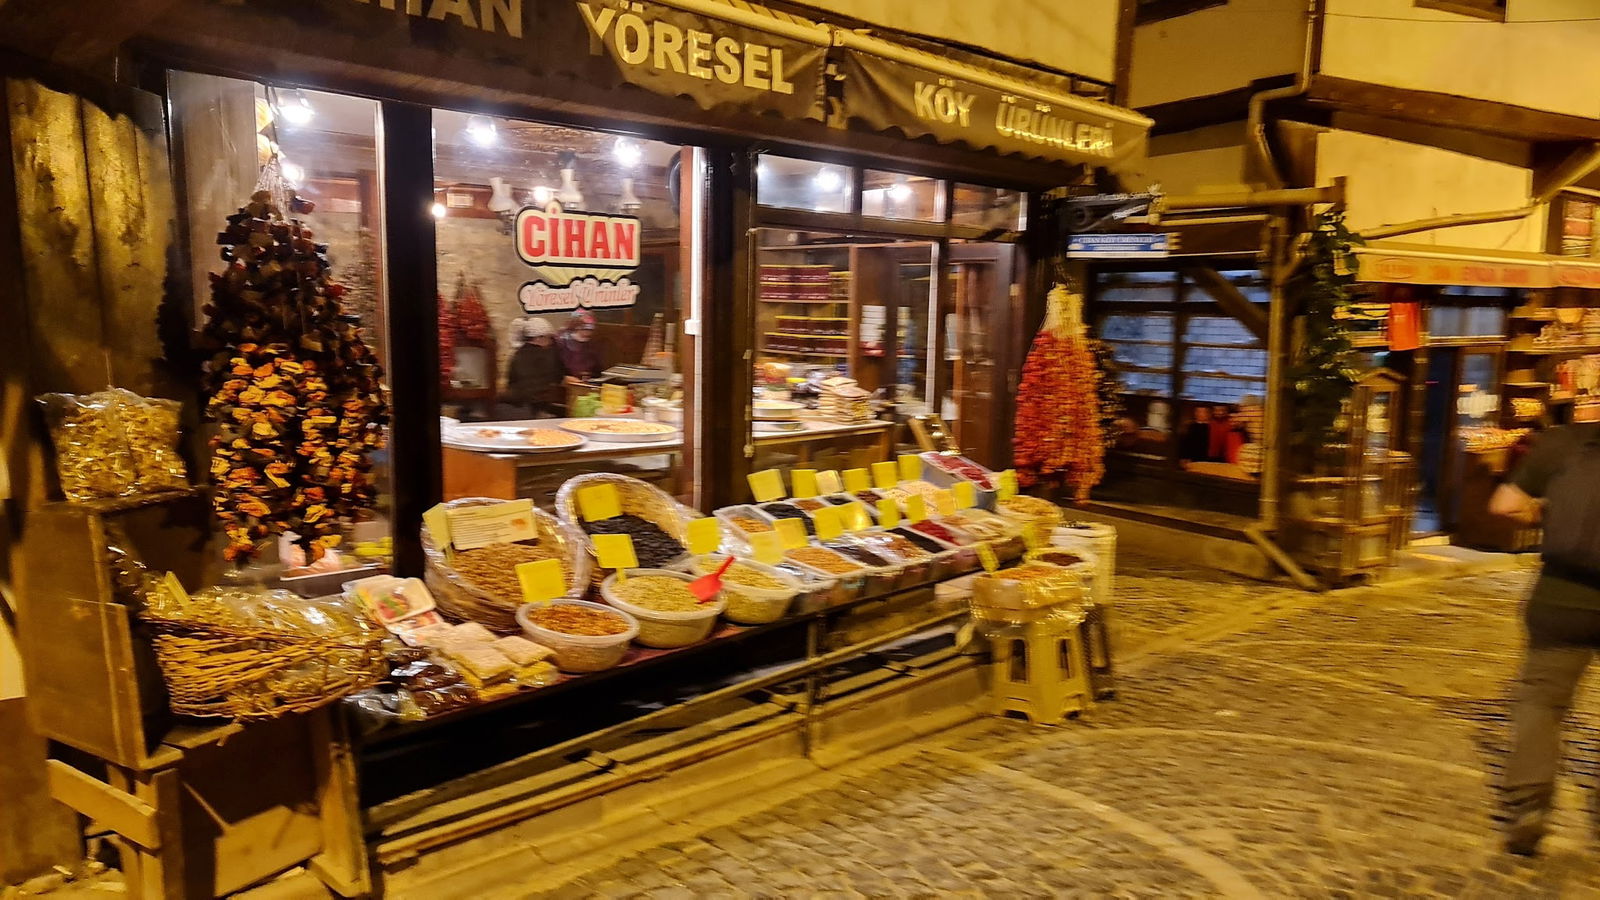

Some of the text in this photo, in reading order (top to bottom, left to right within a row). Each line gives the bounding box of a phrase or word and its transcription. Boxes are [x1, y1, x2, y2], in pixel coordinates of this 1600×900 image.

[577, 1, 794, 95] YÖRESEL
[914, 77, 976, 128] KÖY
[994, 94, 1114, 159] ÜRÜNLERİ
[524, 208, 634, 260] CİHAN
